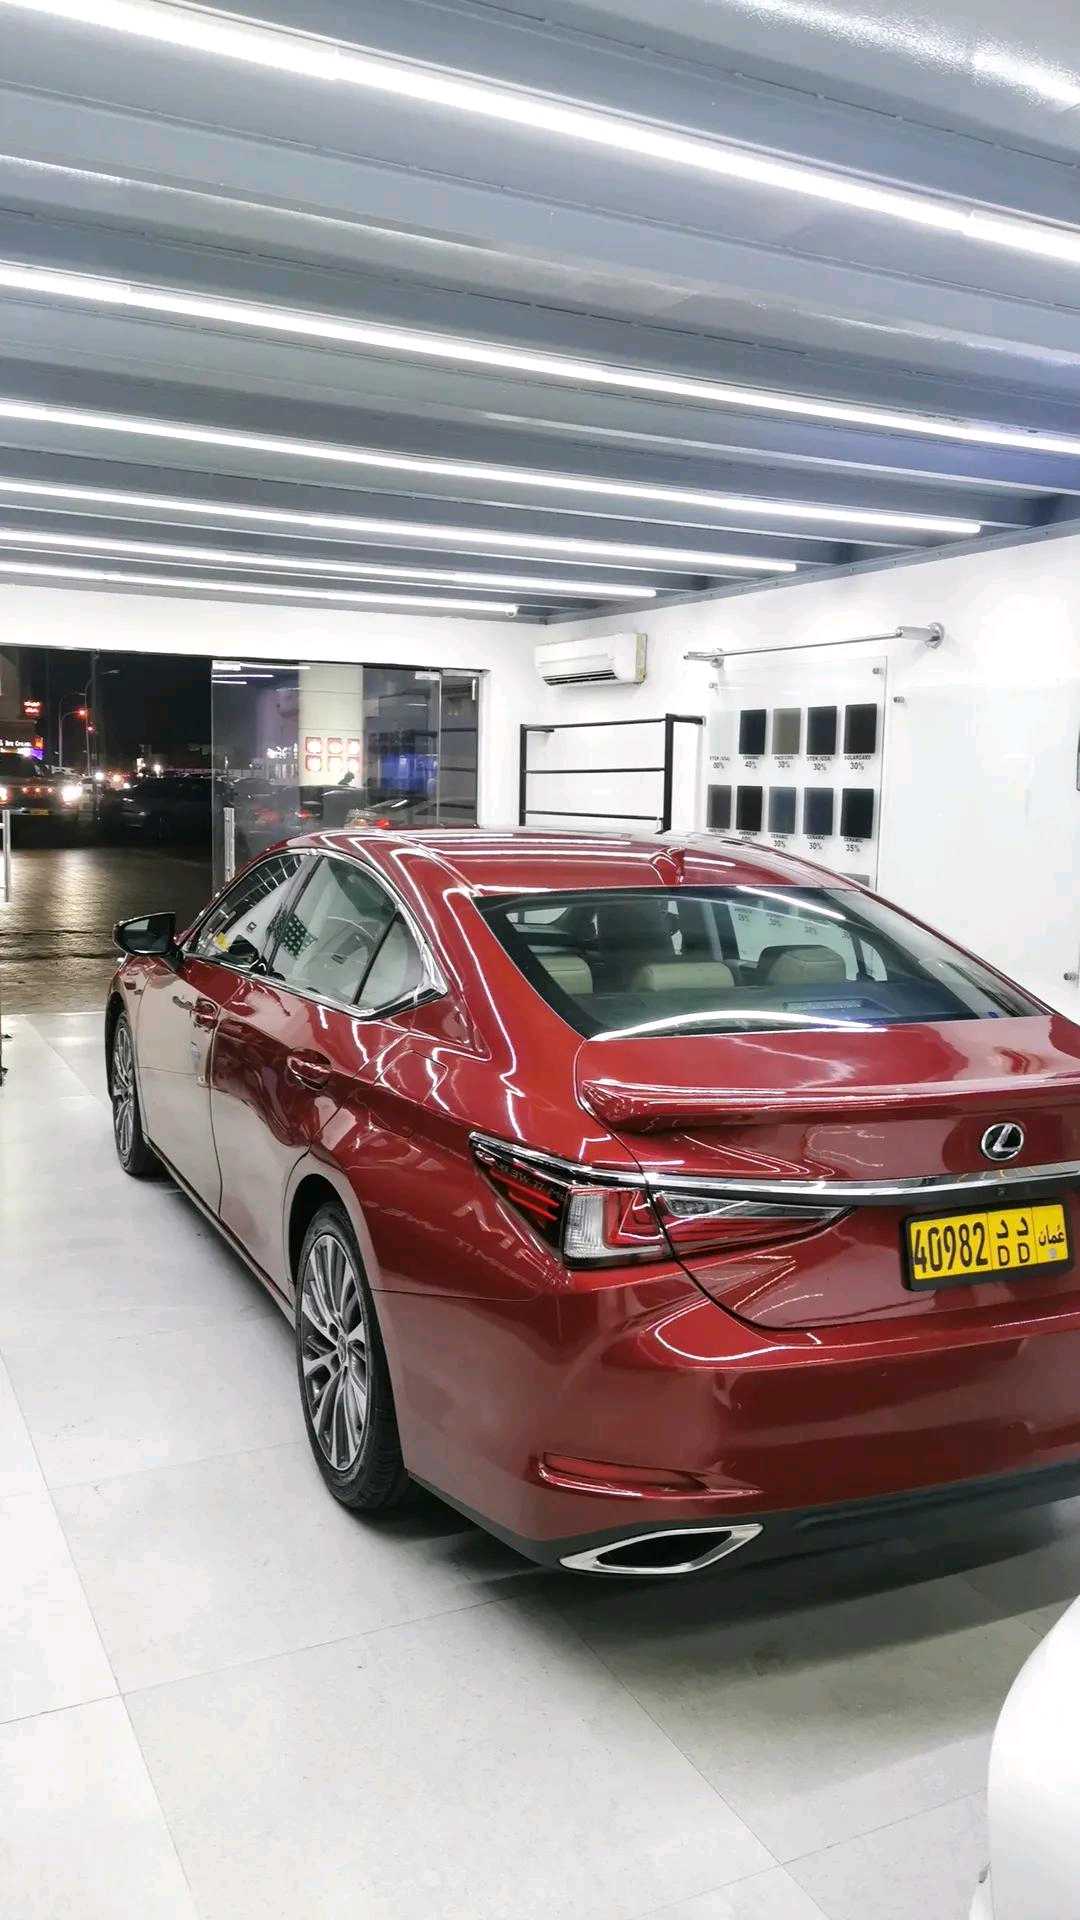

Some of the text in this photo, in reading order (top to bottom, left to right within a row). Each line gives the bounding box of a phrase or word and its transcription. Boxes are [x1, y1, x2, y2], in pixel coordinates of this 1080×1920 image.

[850, 762, 865, 770] 30%
[808, 842, 823, 850] 30%
[845, 844, 861, 853] 35%
[913, 1221, 989, 1273] 40982
[997, 1243, 1031, 1267] D D
